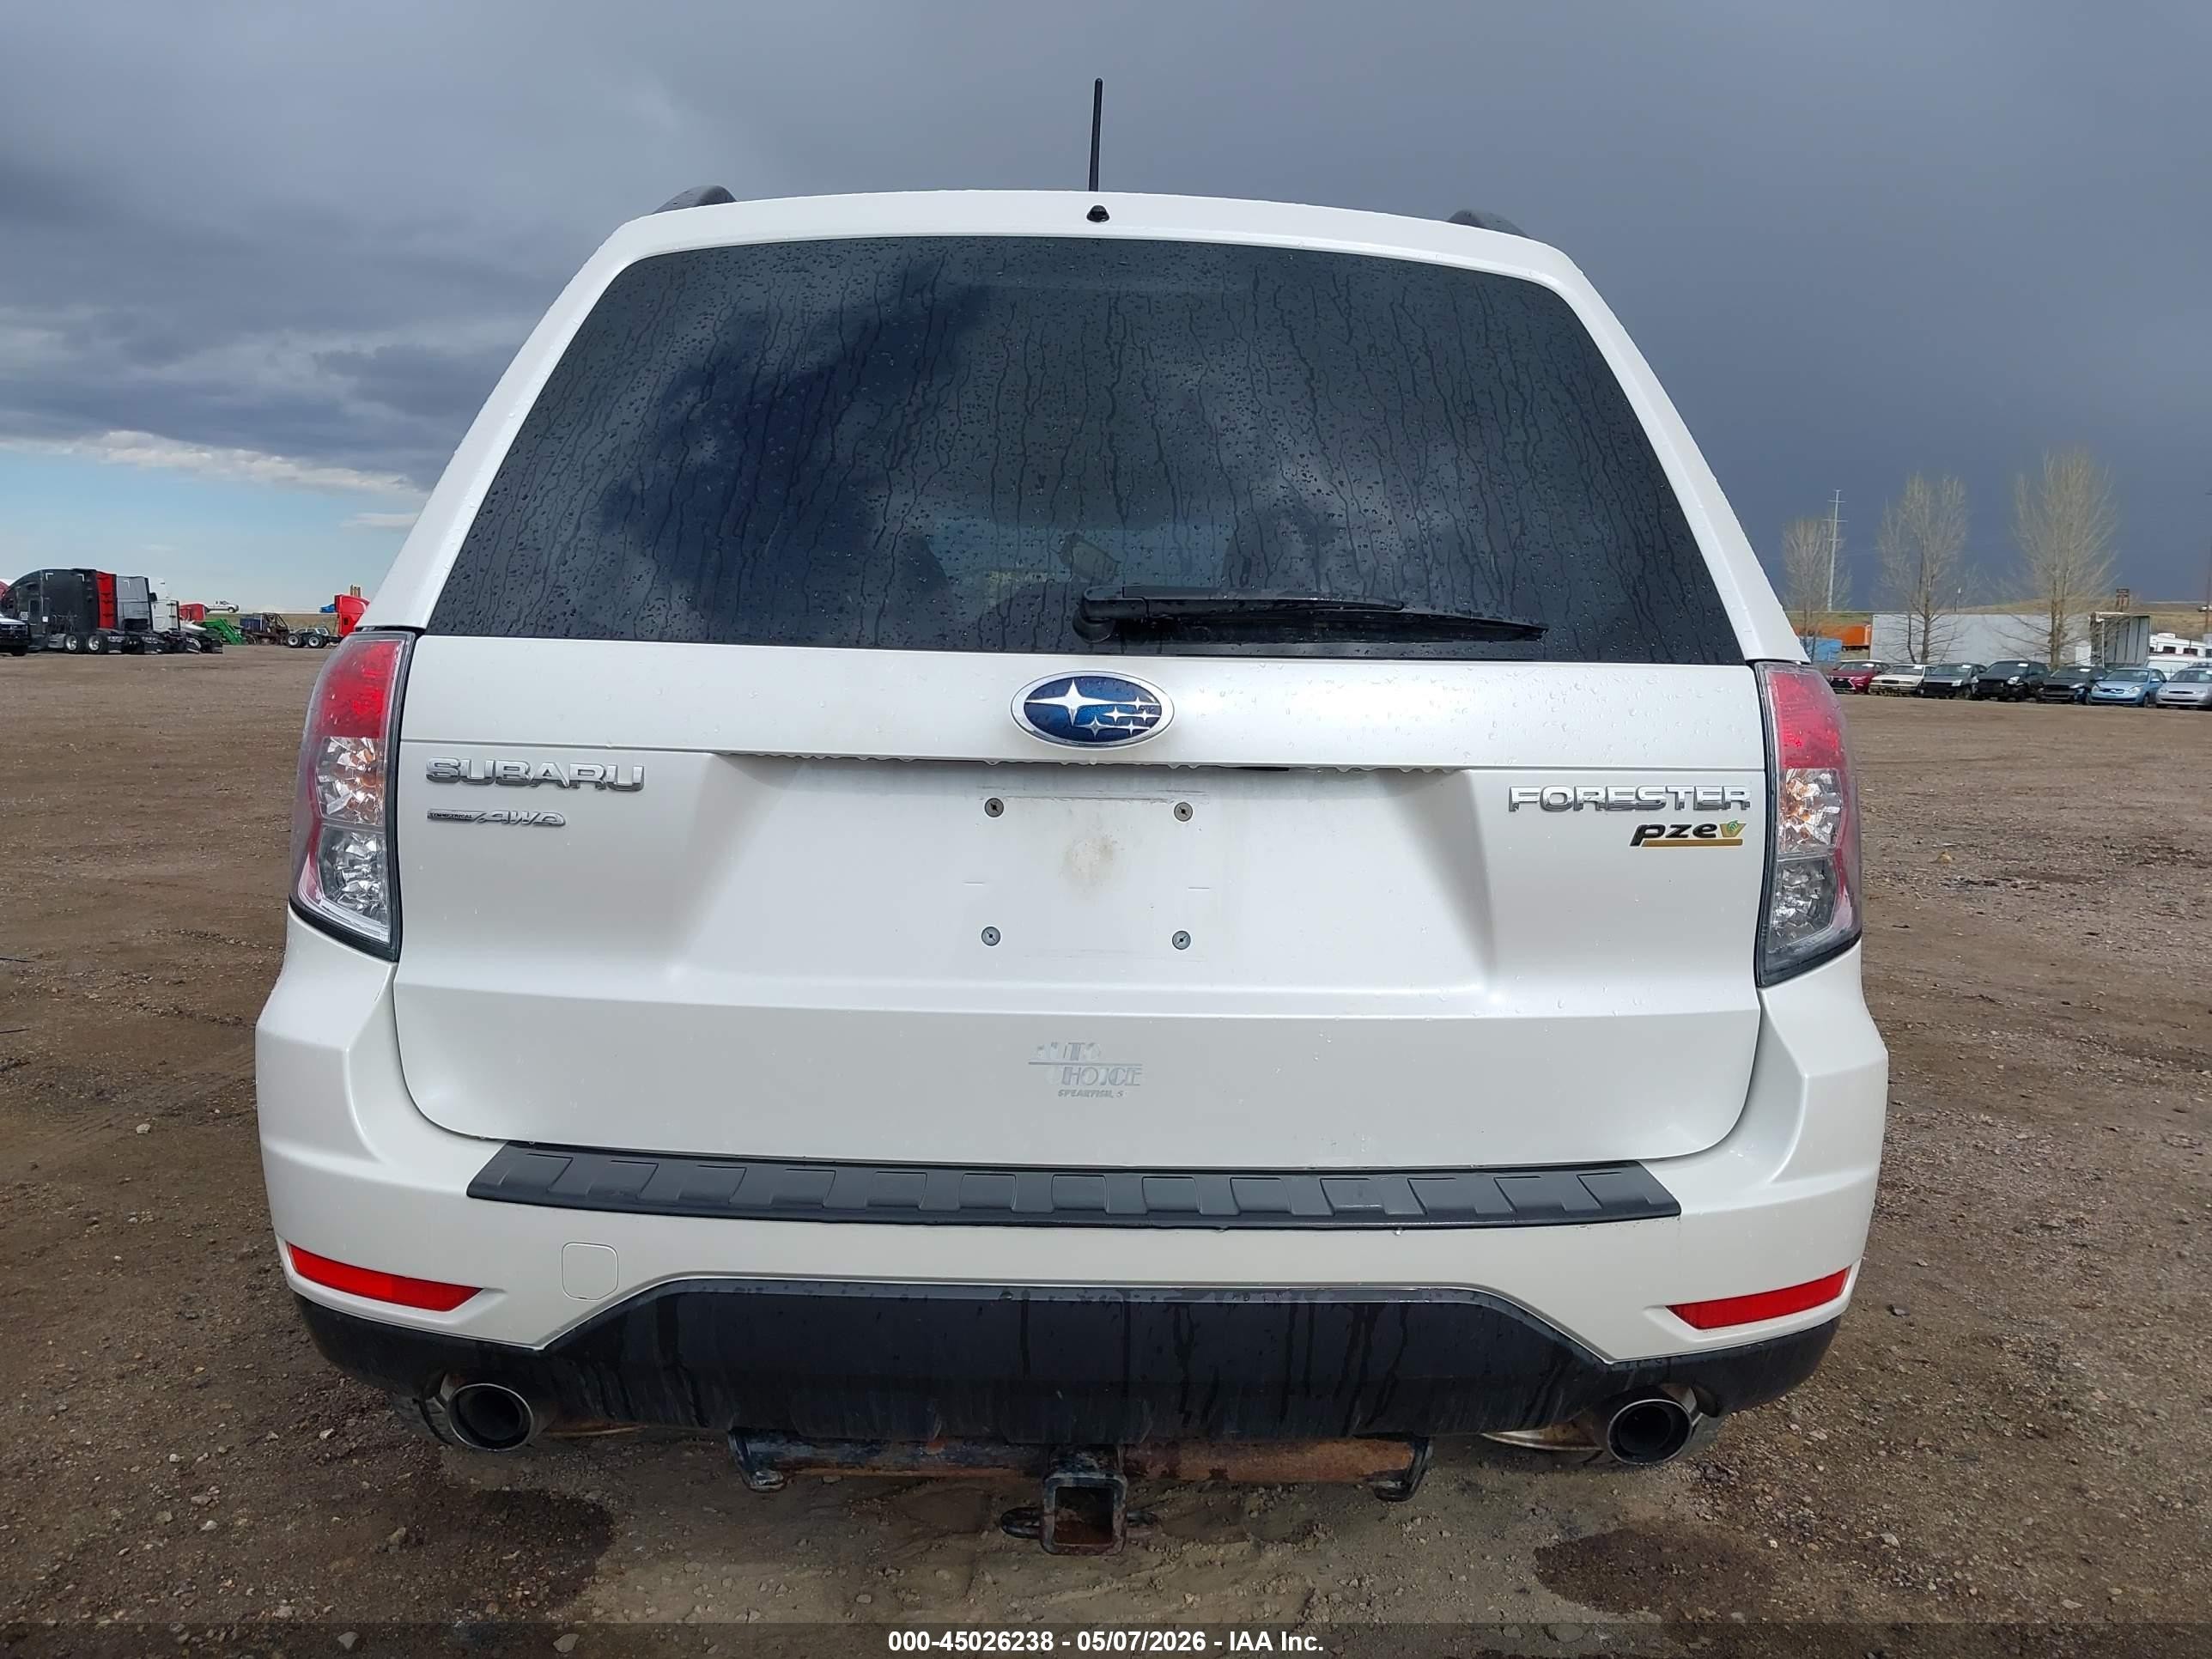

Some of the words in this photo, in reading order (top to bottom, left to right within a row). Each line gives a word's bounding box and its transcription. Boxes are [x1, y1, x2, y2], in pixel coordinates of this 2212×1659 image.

[426, 757, 644, 791] SUBARU
[1509, 785, 1751, 811] FORESTER
[477, 810, 566, 826] AWD
